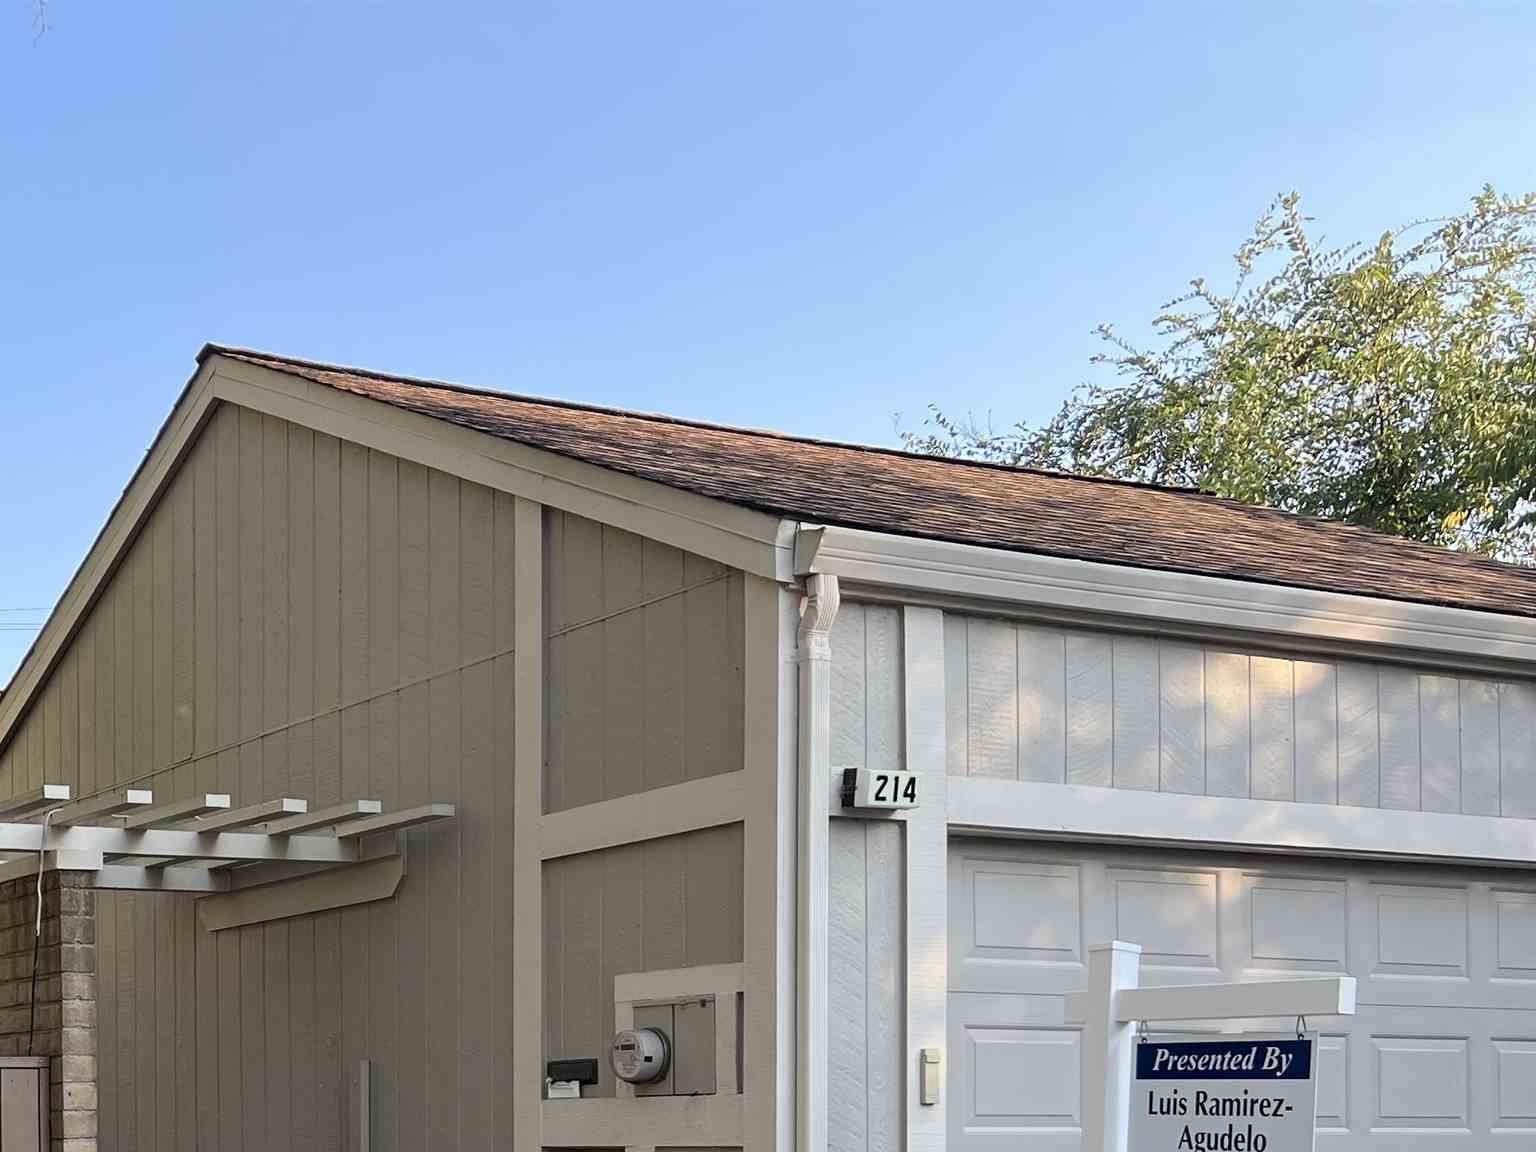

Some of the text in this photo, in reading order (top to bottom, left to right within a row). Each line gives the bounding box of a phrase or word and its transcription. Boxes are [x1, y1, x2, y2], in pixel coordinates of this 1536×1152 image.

[874, 774, 917, 803] 214
[1152, 1045, 1293, 1077] Presented By
[1147, 1088, 1293, 1118] Luis Ramirez-
